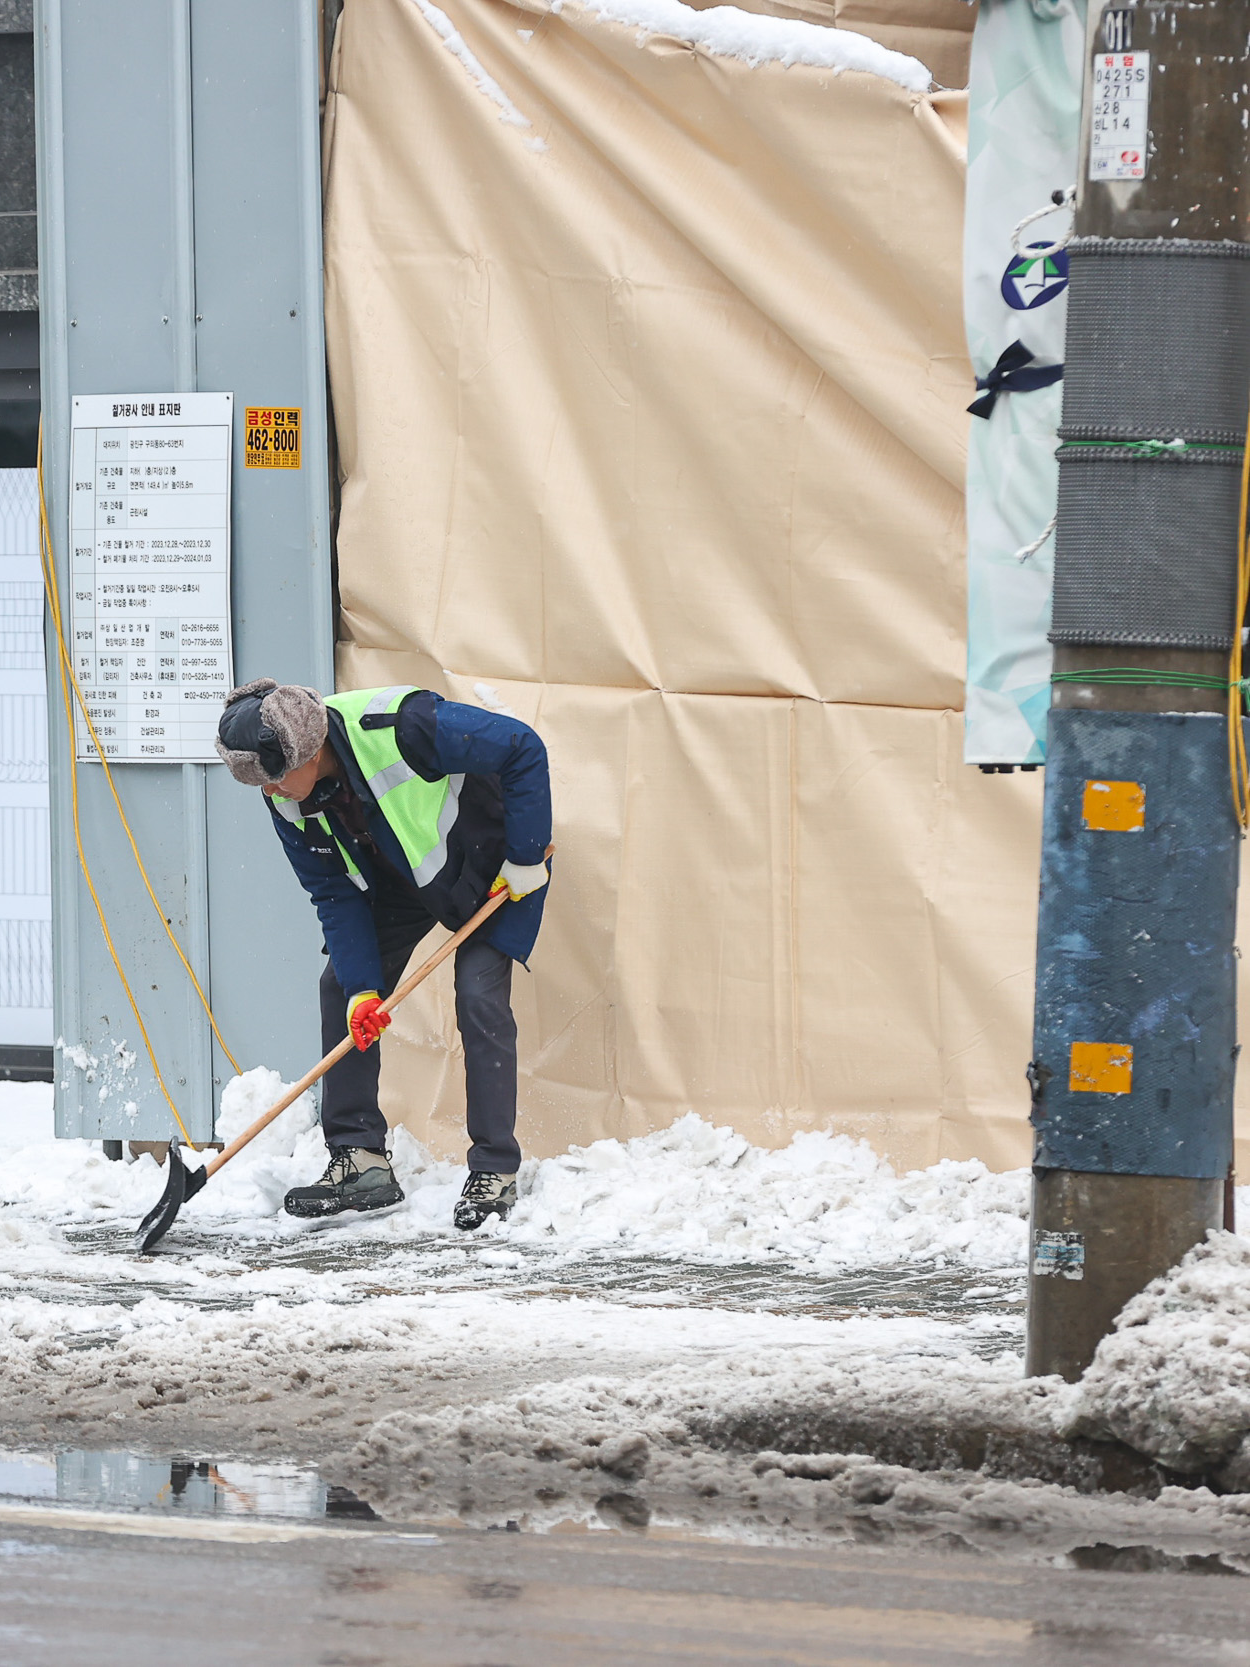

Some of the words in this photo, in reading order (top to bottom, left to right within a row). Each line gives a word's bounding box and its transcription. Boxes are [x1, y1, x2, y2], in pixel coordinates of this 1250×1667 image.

[1096, 68, 1146, 83] 0425S
[1104, 86, 1130, 98] 271
[141, 404, 154, 416] 안내
[159, 403, 181, 416] 표지판
[248, 411, 298, 426] 금성인력
[160, 630, 174, 639] 연락처
[160, 658, 174, 666] 연락처
